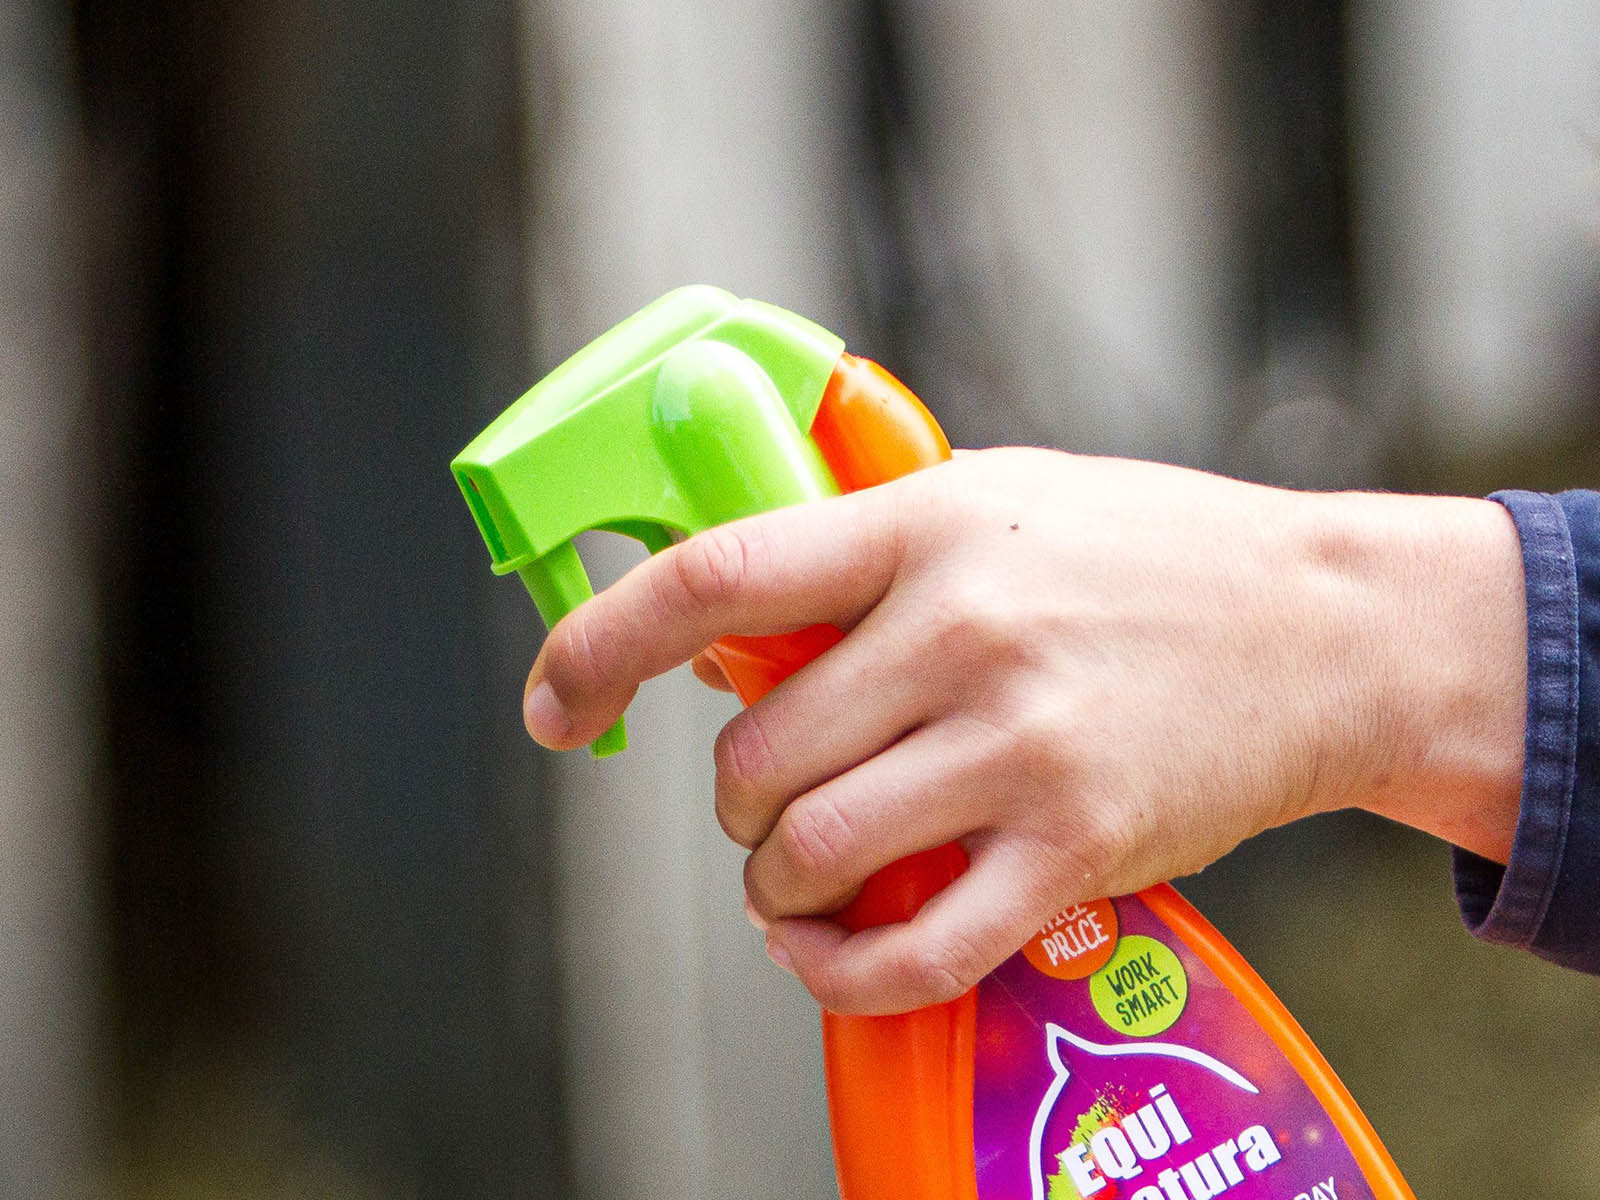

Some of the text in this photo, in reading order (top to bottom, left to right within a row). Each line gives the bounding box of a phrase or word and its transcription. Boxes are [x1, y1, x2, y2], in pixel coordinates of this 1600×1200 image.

[1041, 911, 1110, 967] PRICE
[1106, 952, 1160, 997] WORK
[1115, 975, 1178, 1026] SMART
